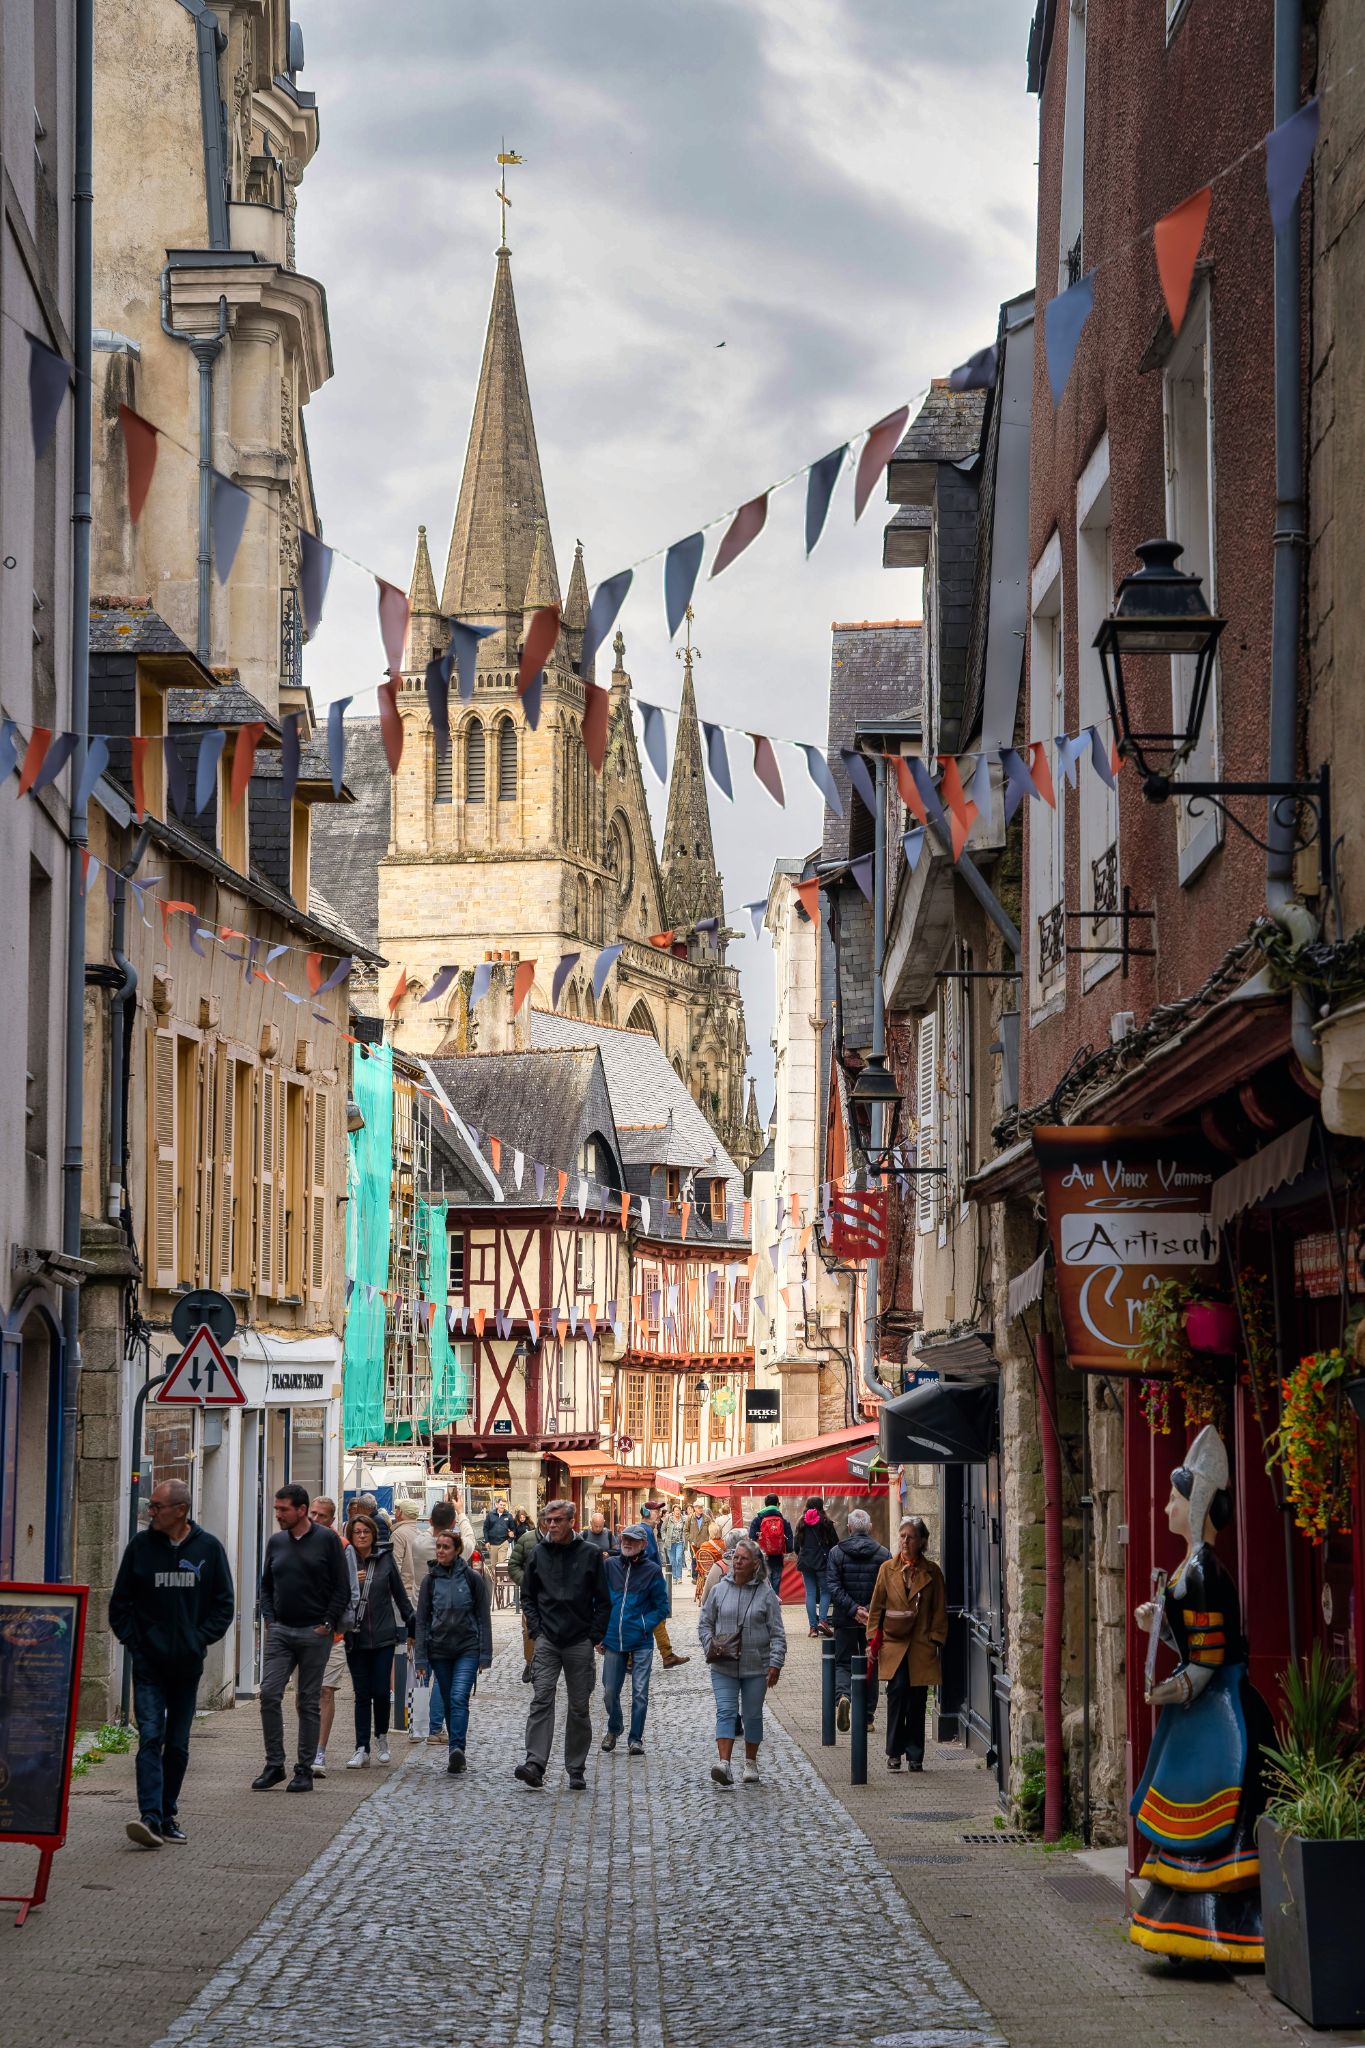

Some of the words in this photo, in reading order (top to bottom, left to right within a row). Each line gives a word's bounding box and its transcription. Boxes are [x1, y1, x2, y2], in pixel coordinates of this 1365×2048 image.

[1062, 1163, 1095, 1190] Au
[1102, 1160, 1148, 1192] Vieux
[1157, 1159, 1213, 1192] Vannes
[272, 1373, 302, 1389] FRAGRANCE
[155, 1572, 195, 1588] PUMA
